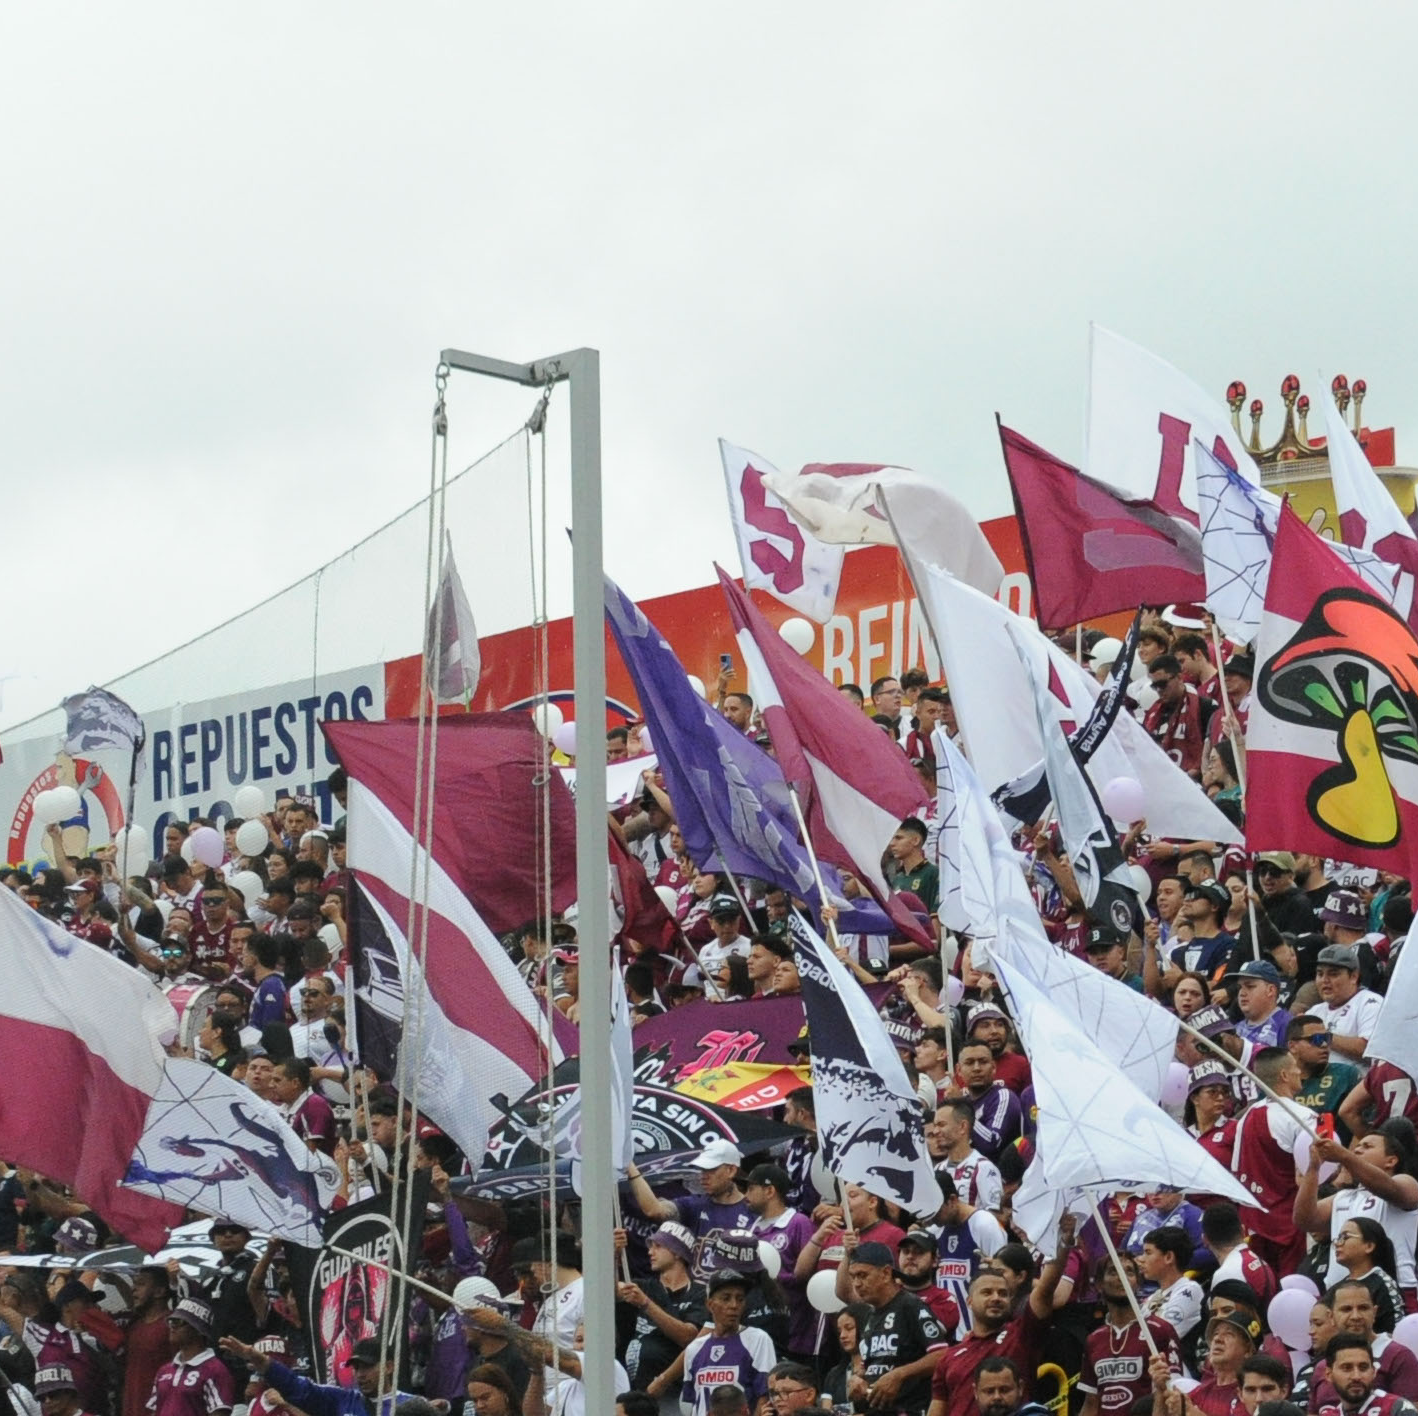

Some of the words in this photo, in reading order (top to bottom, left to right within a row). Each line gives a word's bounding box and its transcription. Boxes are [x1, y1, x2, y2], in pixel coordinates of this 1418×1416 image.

[153, 684, 373, 801] REPUESTOS
[912, 879, 920, 890] S
[1343, 875, 1369, 886] BAC
[1092, 930, 1099, 941] B
[1320, 1075, 1332, 1087] S
[1383, 1079, 1410, 1117] 7
[663, 1105, 706, 1133] SIN
[736, 1215, 749, 1228] S
[561, 1292, 572, 1303] S
[884, 1313, 895, 1328] S
[870, 1334, 898, 1352] BAC
[864, 1364, 897, 1375] ERTY
[184, 1371, 200, 1386] S
